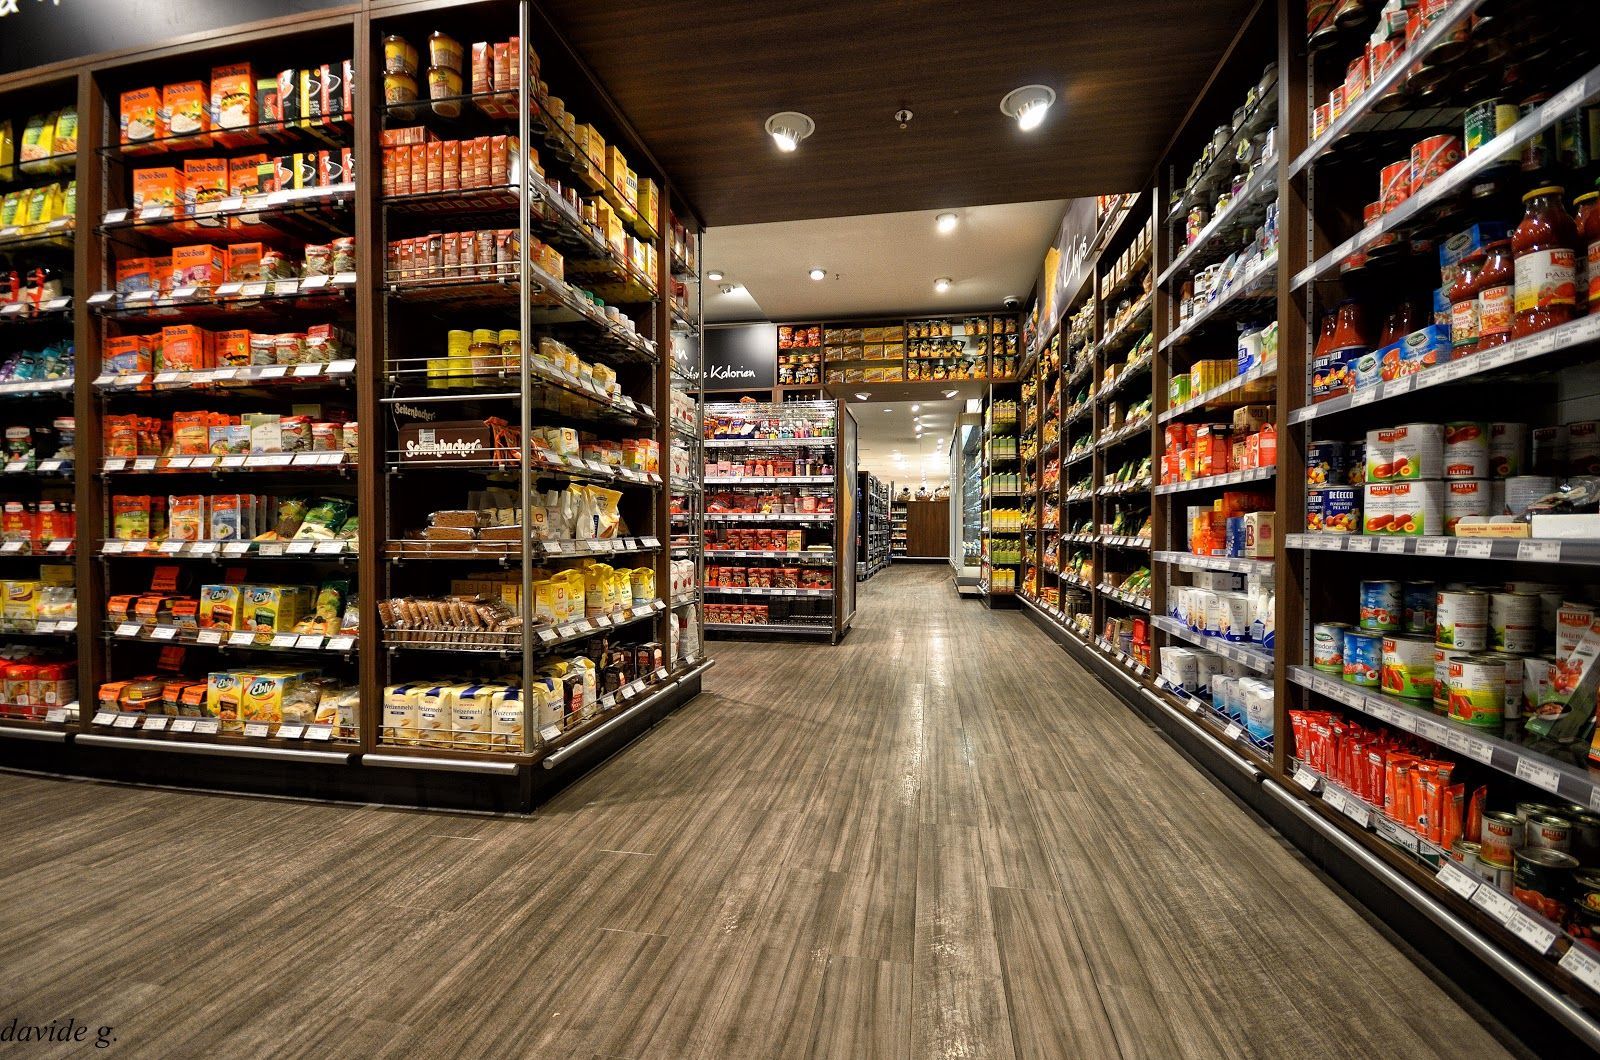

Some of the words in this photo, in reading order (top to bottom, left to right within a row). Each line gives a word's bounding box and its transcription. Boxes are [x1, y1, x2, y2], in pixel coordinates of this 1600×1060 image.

[710, 364, 756, 379] Kalorien
[394, 402, 435, 421] Seitenbacher
[211, 590, 229, 601] Ebly
[217, 678, 234, 688] Ebly
[251, 681, 274, 695] Ebly
[384, 703, 413, 711] Weizenmehl
[453, 707, 483, 715] Weizenmehl
[493, 709, 524, 717] Weizenmeh
